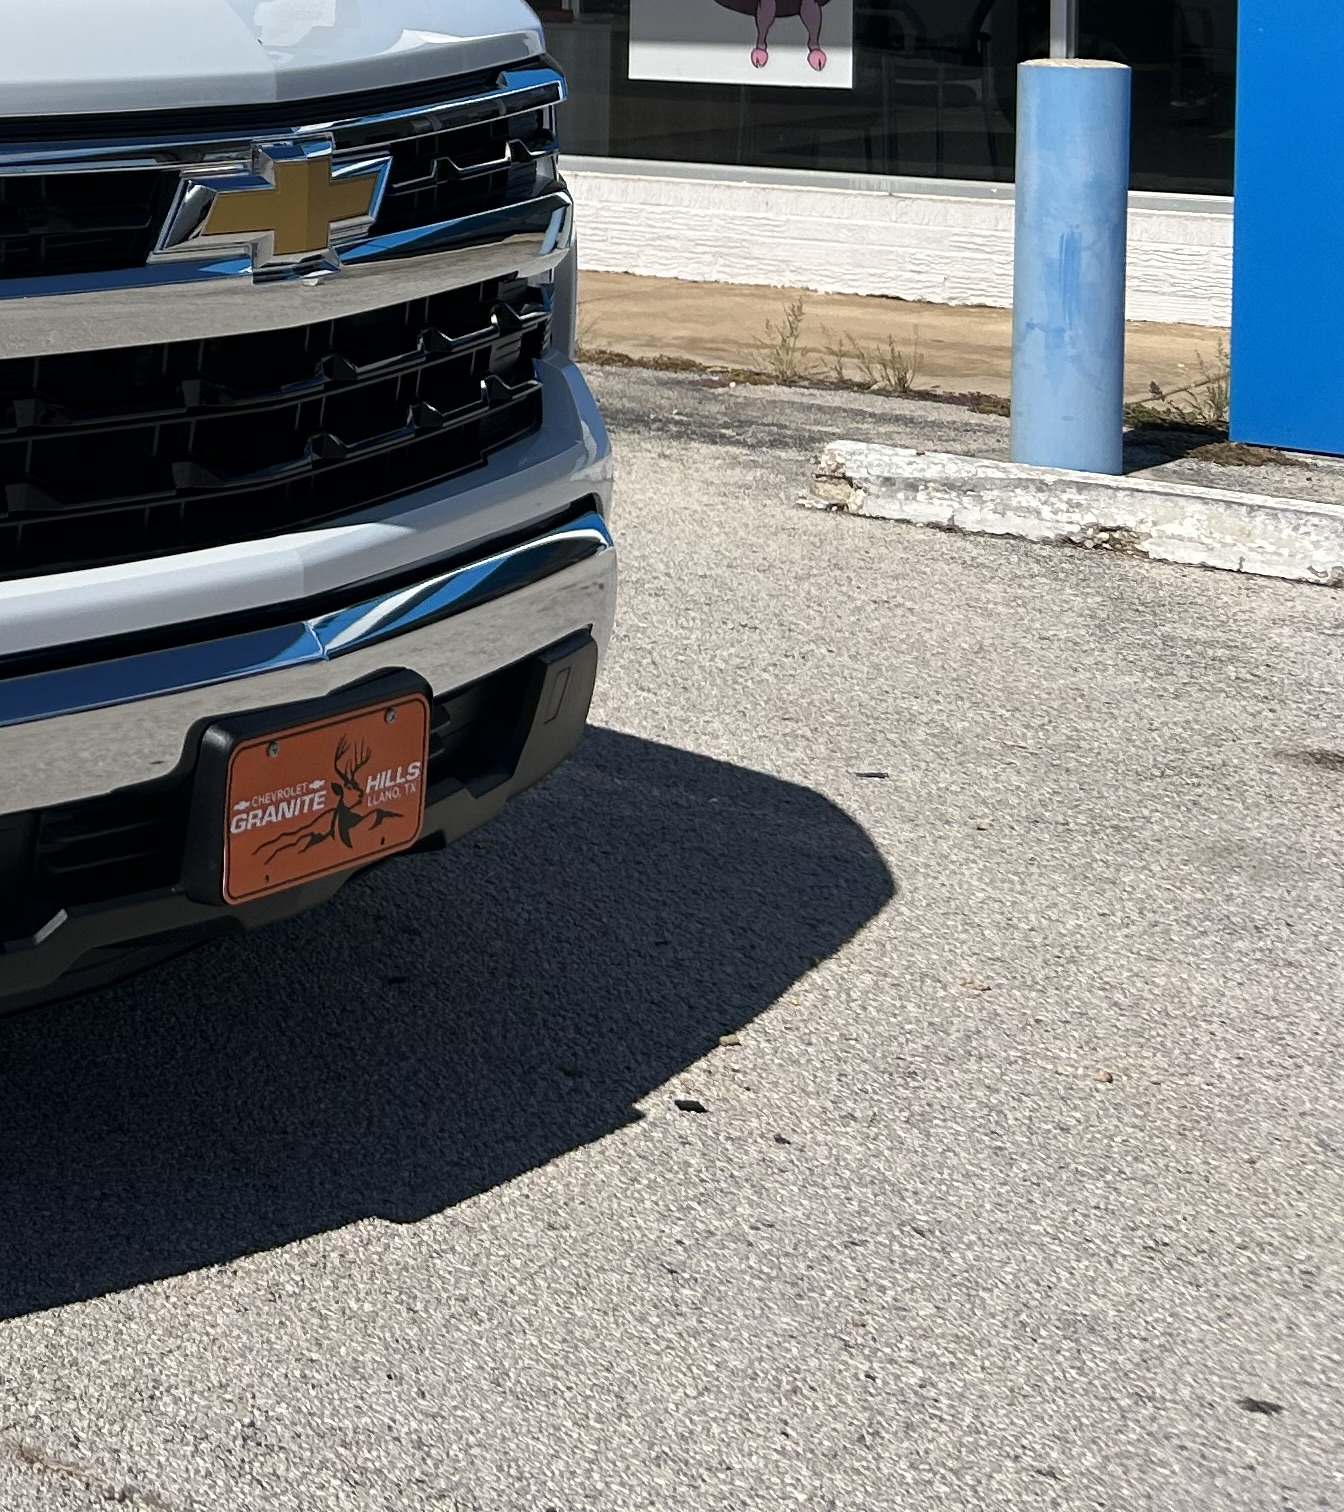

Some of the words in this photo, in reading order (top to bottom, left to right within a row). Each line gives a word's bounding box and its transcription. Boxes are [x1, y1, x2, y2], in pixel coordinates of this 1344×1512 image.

[230, 790, 327, 834] GRANITE
[366, 761, 421, 794] HILLS
[251, 782, 308, 808] CHEVROLET
[404, 782, 417, 796] TX
